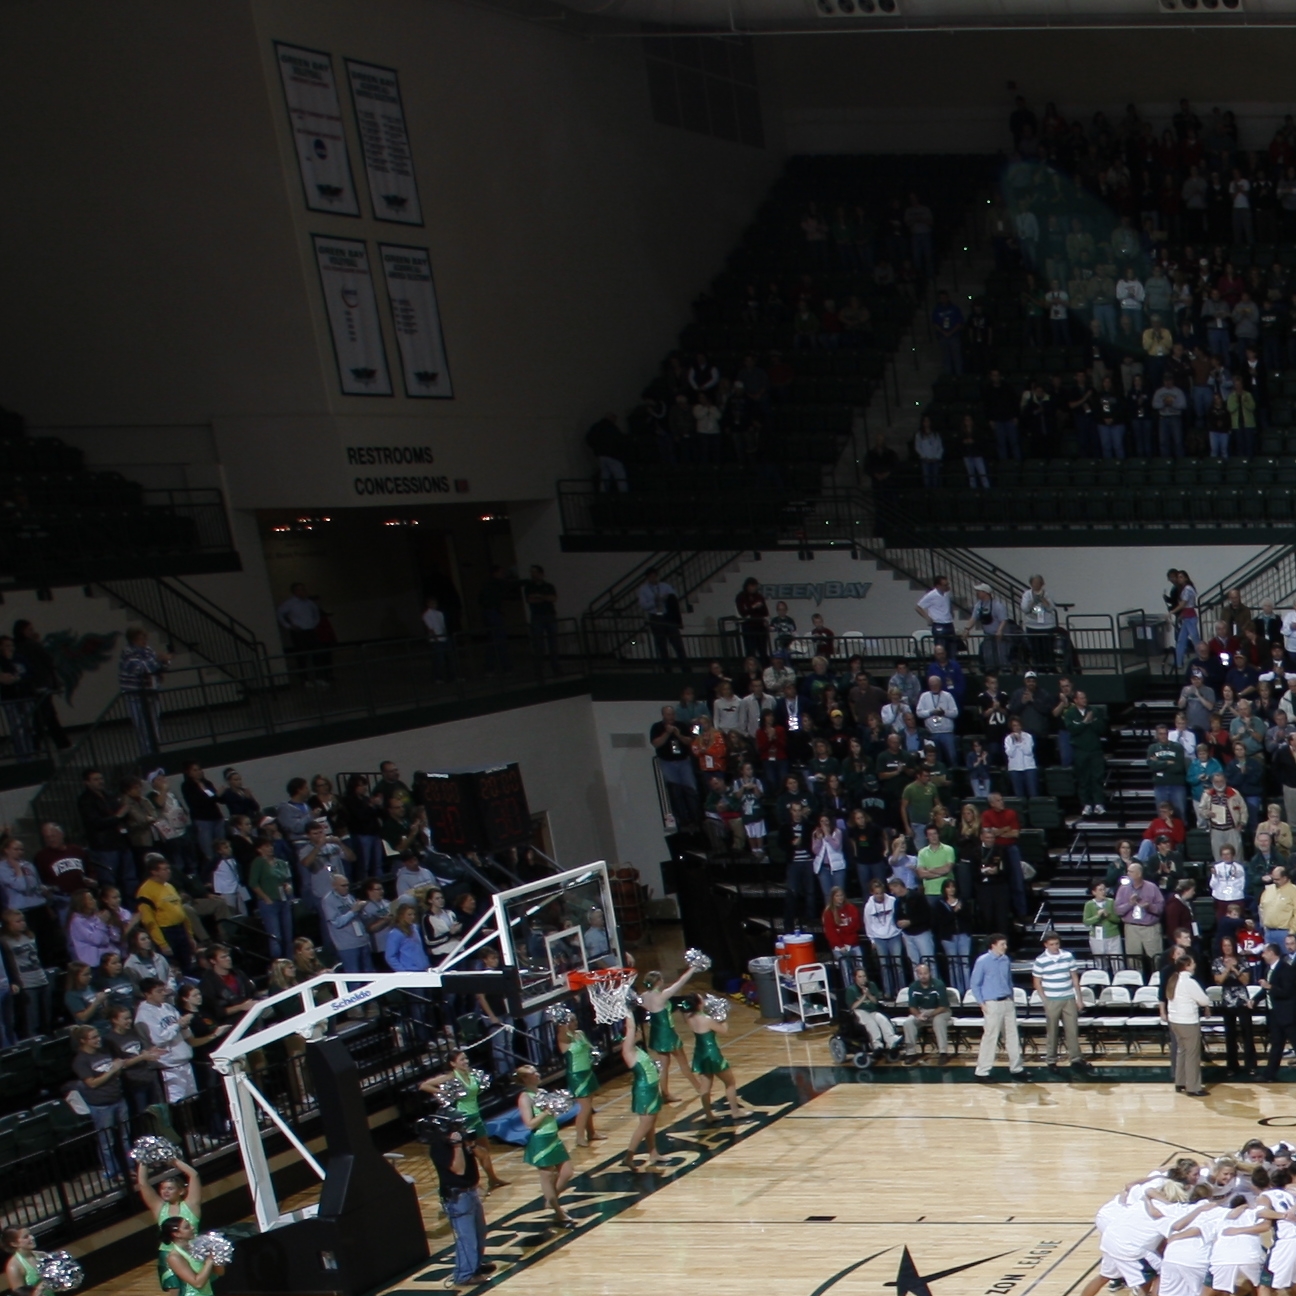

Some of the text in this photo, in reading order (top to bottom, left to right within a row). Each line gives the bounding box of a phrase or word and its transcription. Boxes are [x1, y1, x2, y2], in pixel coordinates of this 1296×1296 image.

[347, 446, 434, 465] RESTROOMS
[374, 476, 450, 495] CONCESSIONS
[759, 581, 873, 607] REEN BAY
[1012, 1239, 1063, 1271] LEAGUE
